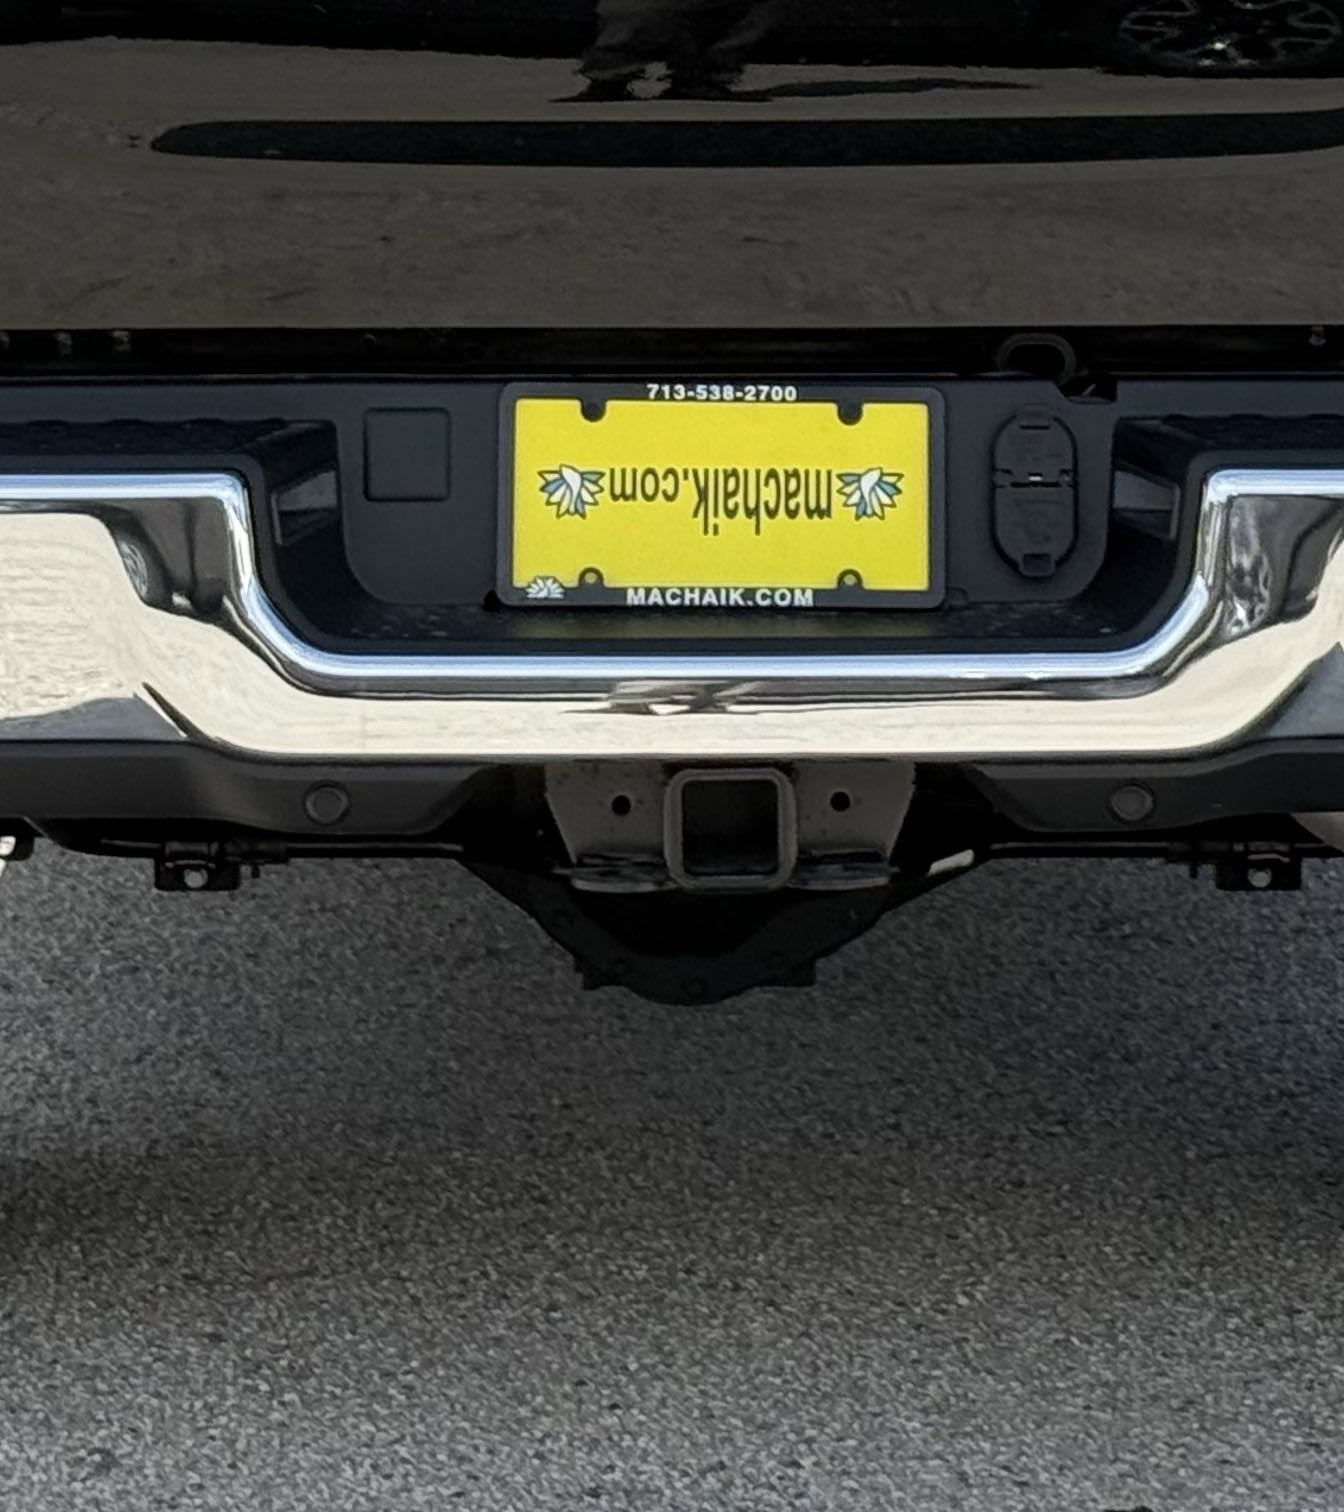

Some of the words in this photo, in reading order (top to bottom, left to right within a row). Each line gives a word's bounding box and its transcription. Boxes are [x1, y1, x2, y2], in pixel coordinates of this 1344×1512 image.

[646, 384, 798, 402] 713-538-2700
[608, 466, 833, 536] machaik.com
[625, 588, 814, 608] MACHAIK.COM
